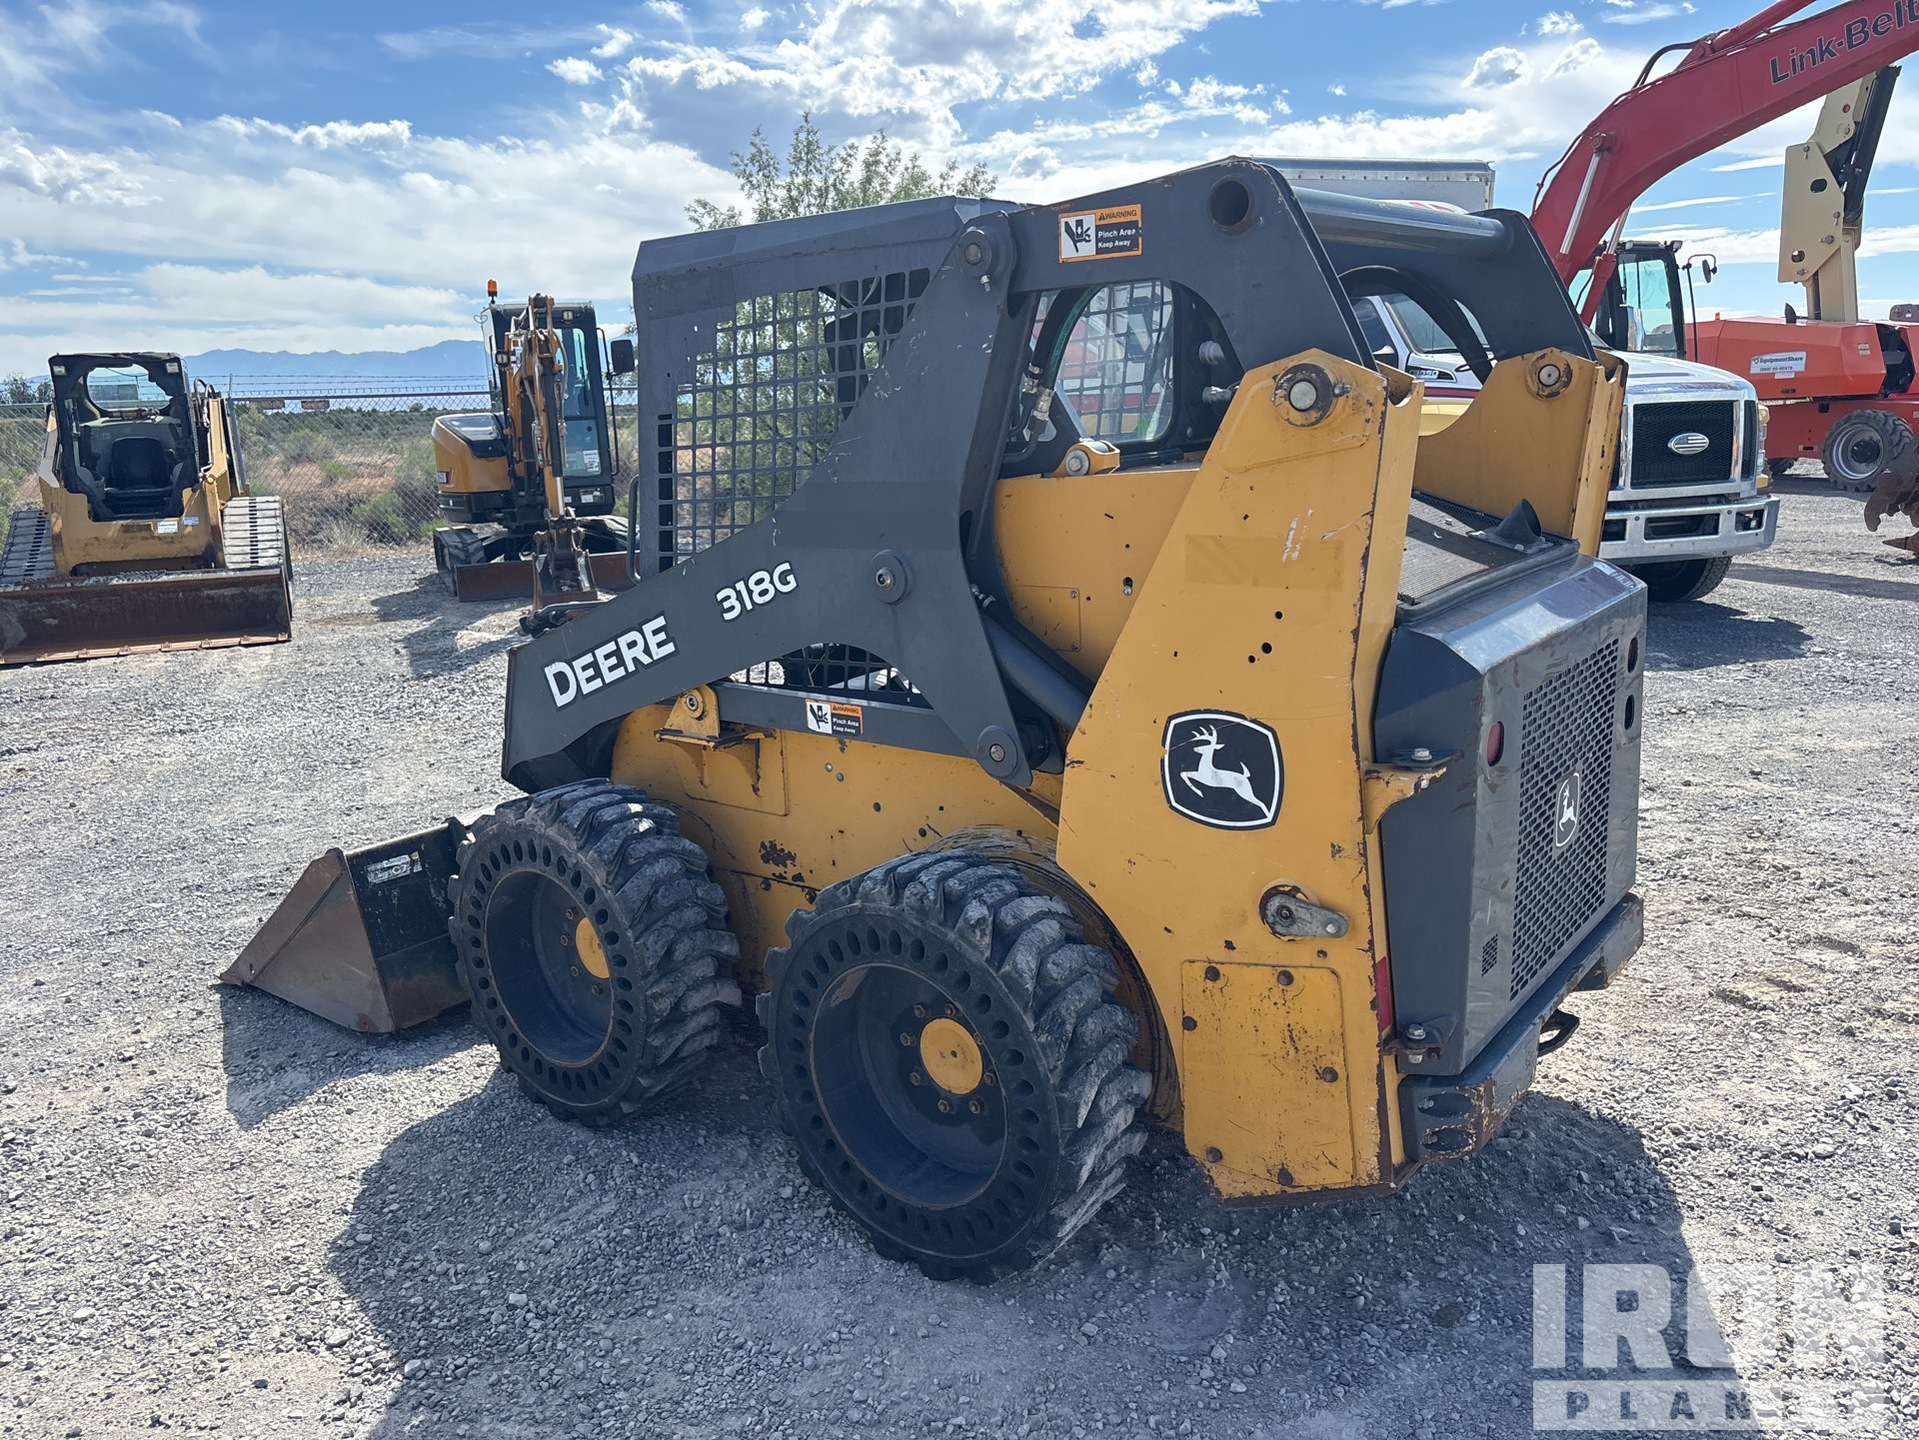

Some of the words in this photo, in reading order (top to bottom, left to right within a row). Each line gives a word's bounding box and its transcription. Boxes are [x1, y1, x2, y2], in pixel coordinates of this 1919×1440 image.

[1769, 0, 1919, 85] Link-Belt
[1104, 210, 1137, 220] WARNING
[1098, 230, 1118, 238] Pinch
[1119, 228, 1136, 236] Area
[1098, 241, 1113, 249] Keep
[715, 562, 798, 621] 318G
[544, 615, 676, 708] DEERE
